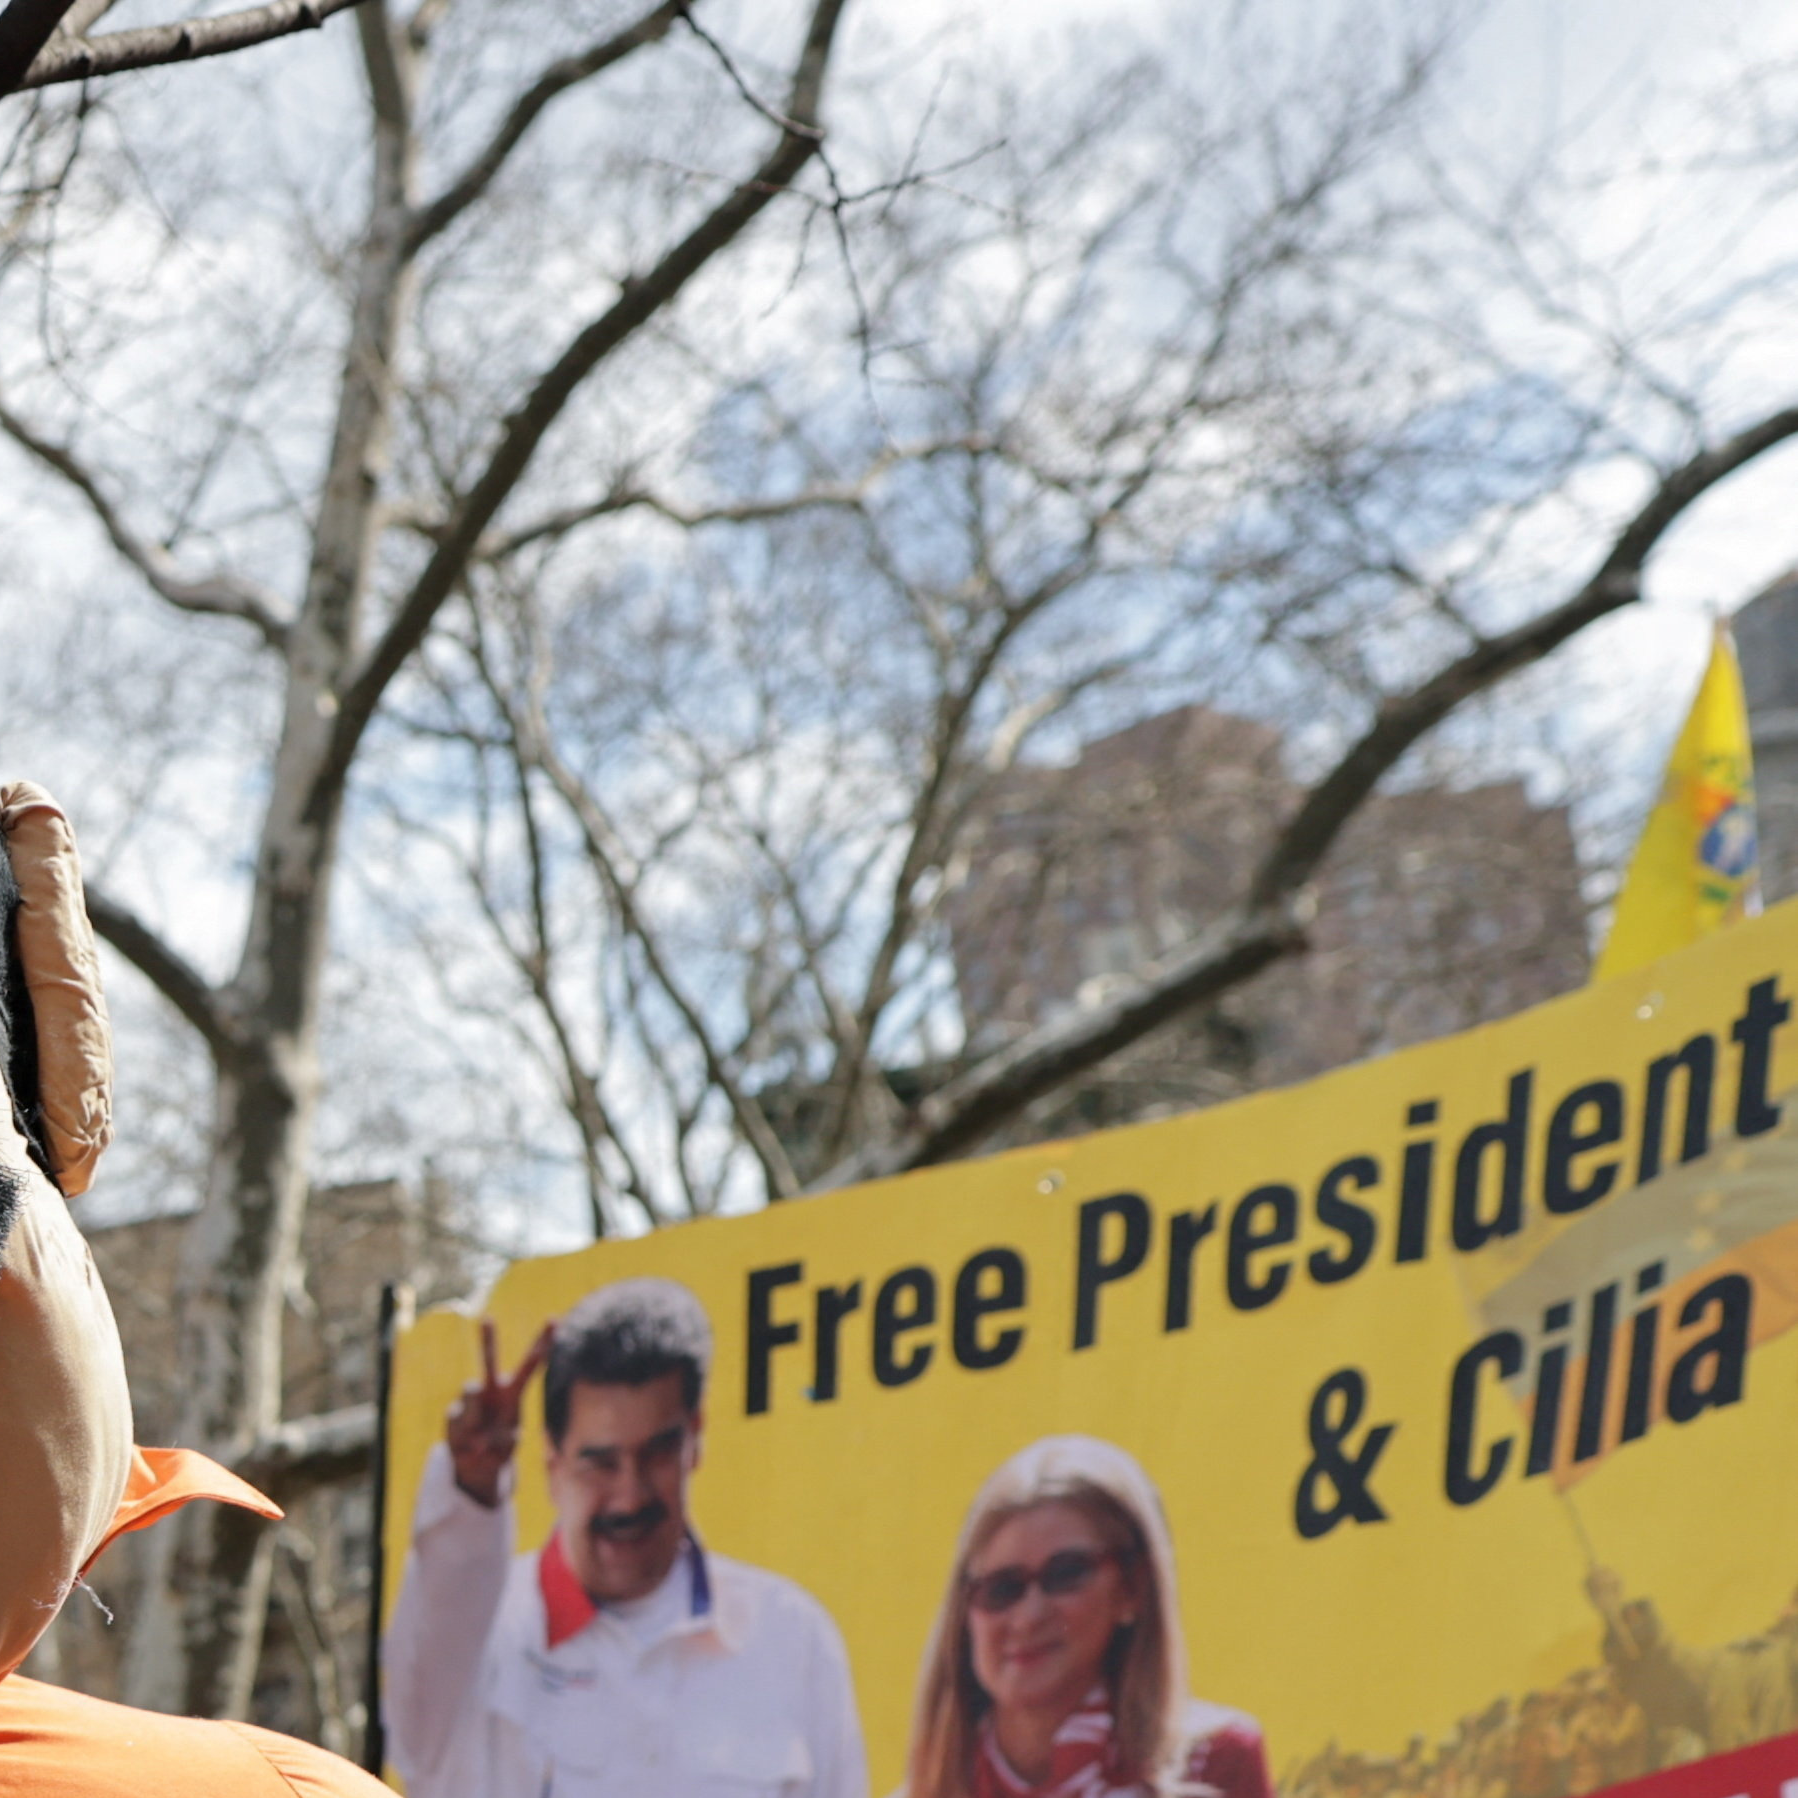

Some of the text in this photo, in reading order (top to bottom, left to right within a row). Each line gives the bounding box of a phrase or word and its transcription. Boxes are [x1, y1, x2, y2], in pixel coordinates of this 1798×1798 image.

[744, 973, 1792, 1417] Free President
[1294, 1259, 1753, 1539] & Cilia
